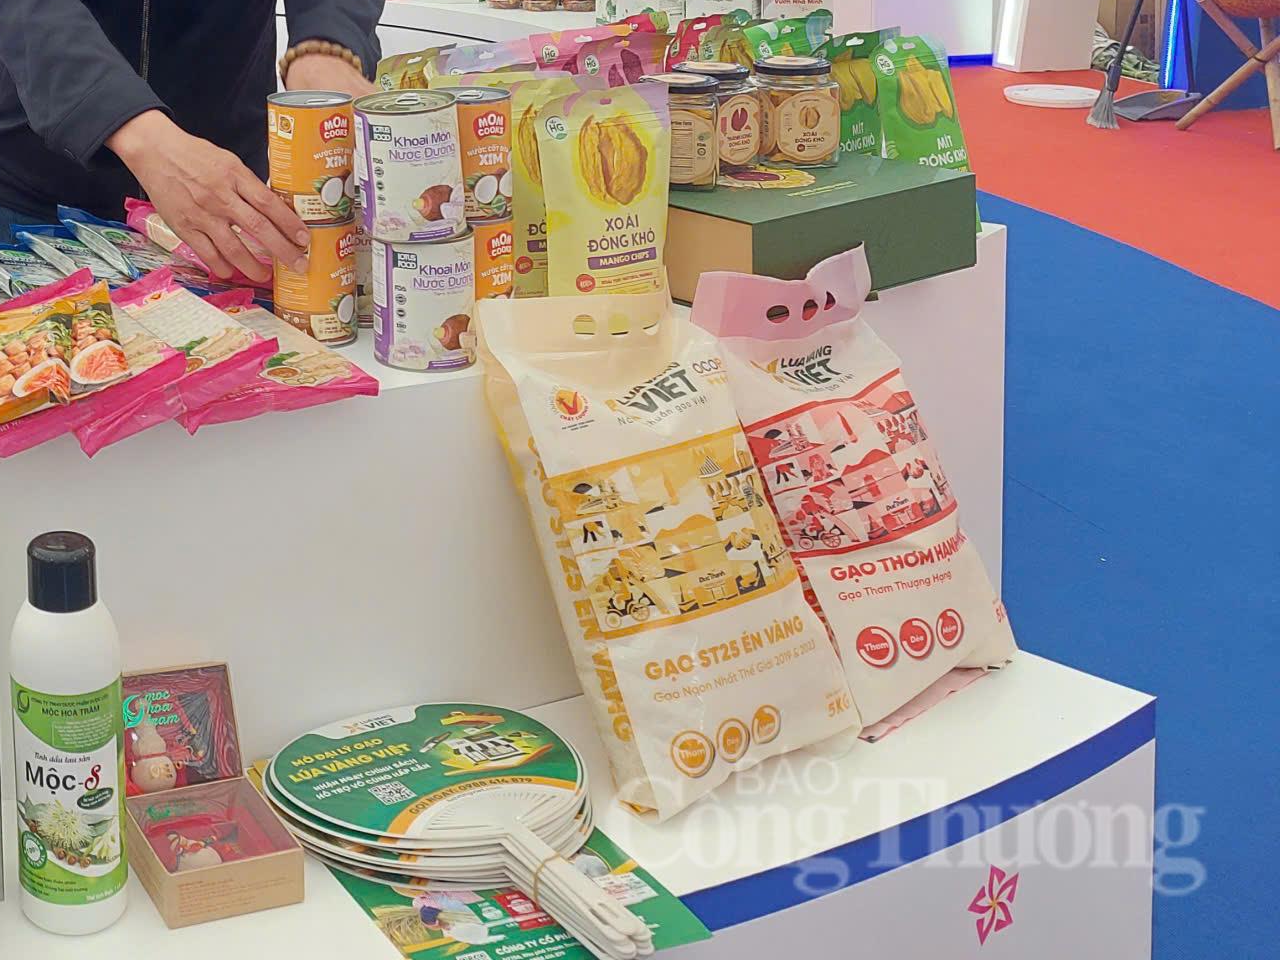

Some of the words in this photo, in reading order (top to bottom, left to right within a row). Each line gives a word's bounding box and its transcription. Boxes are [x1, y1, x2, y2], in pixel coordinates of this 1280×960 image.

[323, 114, 348, 131] MOM
[550, 123, 564, 132] HG
[323, 128, 348, 139] COOKS
[393, 136, 429, 147] Khoai
[432, 131, 452, 145] Môn
[937, 134, 952, 150] MÍT
[389, 150, 420, 161] Nước
[422, 144, 456, 160] Đường
[605, 214, 639, 231] XOÀI
[587, 234, 629, 252] ĐÔNG
[631, 227, 656, 245] KHÔ
[599, 255, 630, 267] MANGO
[631, 251, 650, 262] CHIPS
[419, 264, 453, 277] Khoai
[830, 561, 877, 583] GẠO
[877, 547, 934, 573] THƠM
[838, 591, 862, 602] Gạo
[895, 577, 931, 590] Thượng
[933, 570, 952, 585] Hạng
[644, 654, 694, 682] GẠO
[697, 640, 740, 669] ST25
[741, 630, 763, 654] ÉN
[764, 616, 805, 646] VÀNG
[683, 681, 713, 698] Ngon
[714, 672, 738, 688] Nhất
[41, 704, 60, 718] MỘC
[61, 707, 79, 717] HOA
[288, 765, 322, 783] LÚA
[322, 751, 376, 777] VÀNG
[376, 742, 413, 761] VIỆT
[25, 761, 102, 795] Mộc-S
